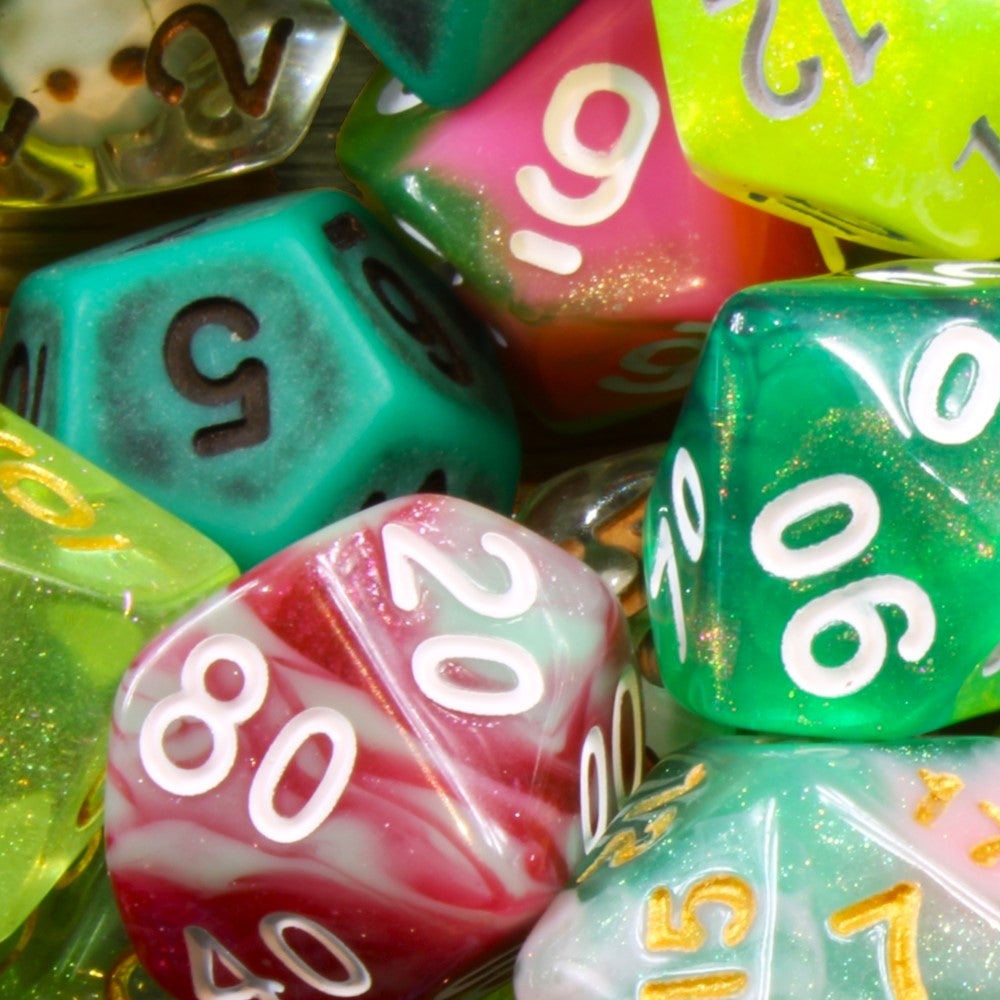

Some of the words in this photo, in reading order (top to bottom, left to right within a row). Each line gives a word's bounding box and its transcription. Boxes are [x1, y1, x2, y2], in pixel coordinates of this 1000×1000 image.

[163, 296, 271, 457] 5
[380, 523, 546, 714] 20
[140, 633, 357, 843] 80
